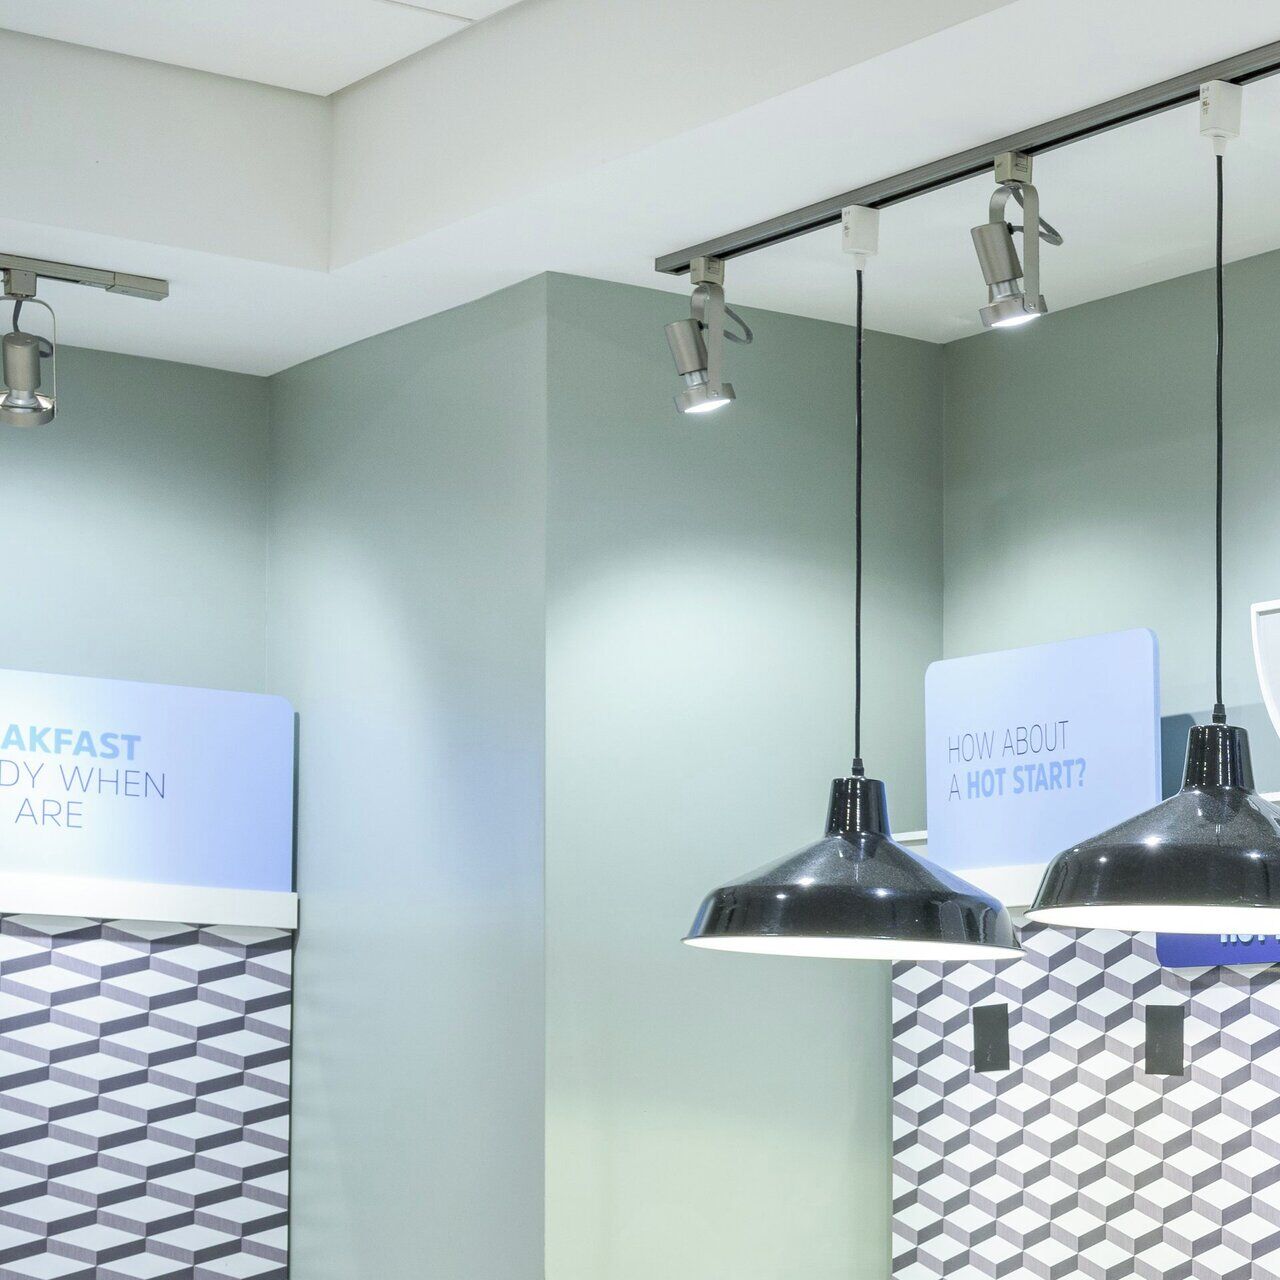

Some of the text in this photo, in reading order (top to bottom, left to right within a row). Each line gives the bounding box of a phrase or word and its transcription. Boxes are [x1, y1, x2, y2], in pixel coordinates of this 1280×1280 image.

[0, 723, 142, 761] AKFAST
[948, 720, 1069, 764] HOW ABOUT
[0, 759, 166, 799] DY WHEN
[948, 757, 1087, 801] A HOT START?
[15, 798, 83, 829] ARE
